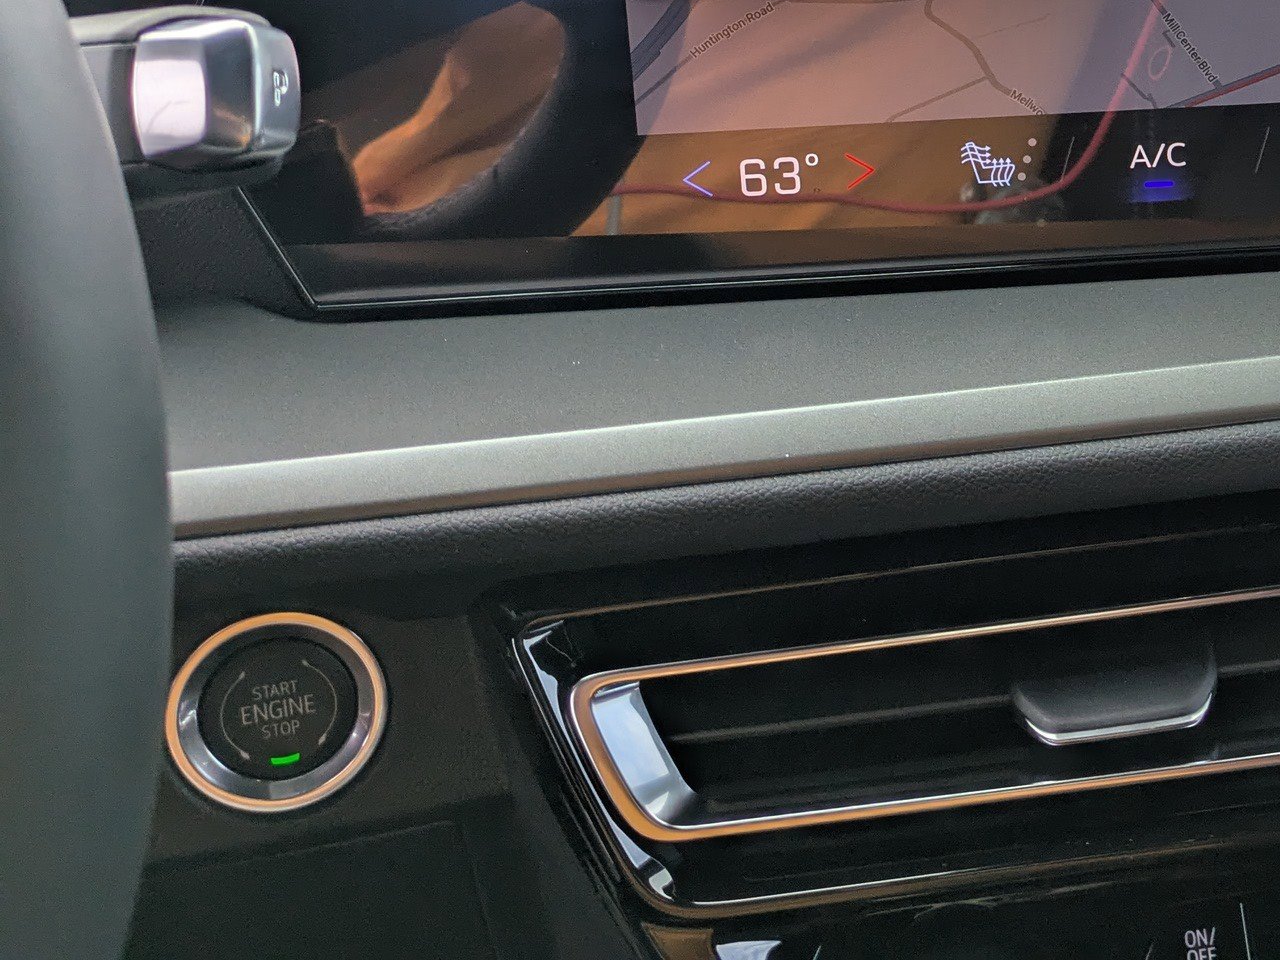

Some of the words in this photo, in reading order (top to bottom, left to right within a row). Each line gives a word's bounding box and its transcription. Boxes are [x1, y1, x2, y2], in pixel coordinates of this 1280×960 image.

[690, 17, 747, 59] Huntington
[745, 1, 775, 25] Road
[1162, 12, 1182, 35] Mill
[1176, 33, 1201, 62] Center
[1198, 59, 1218, 83] Blvd
[1129, 142, 1187, 169] A/C
[252, 680, 298, 700] START
[240, 694, 316, 726] ENGINE
[261, 720, 301, 740] STOP
[1184, 927, 1216, 948] ON/
[1186, 946, 1217, 960] OFF
